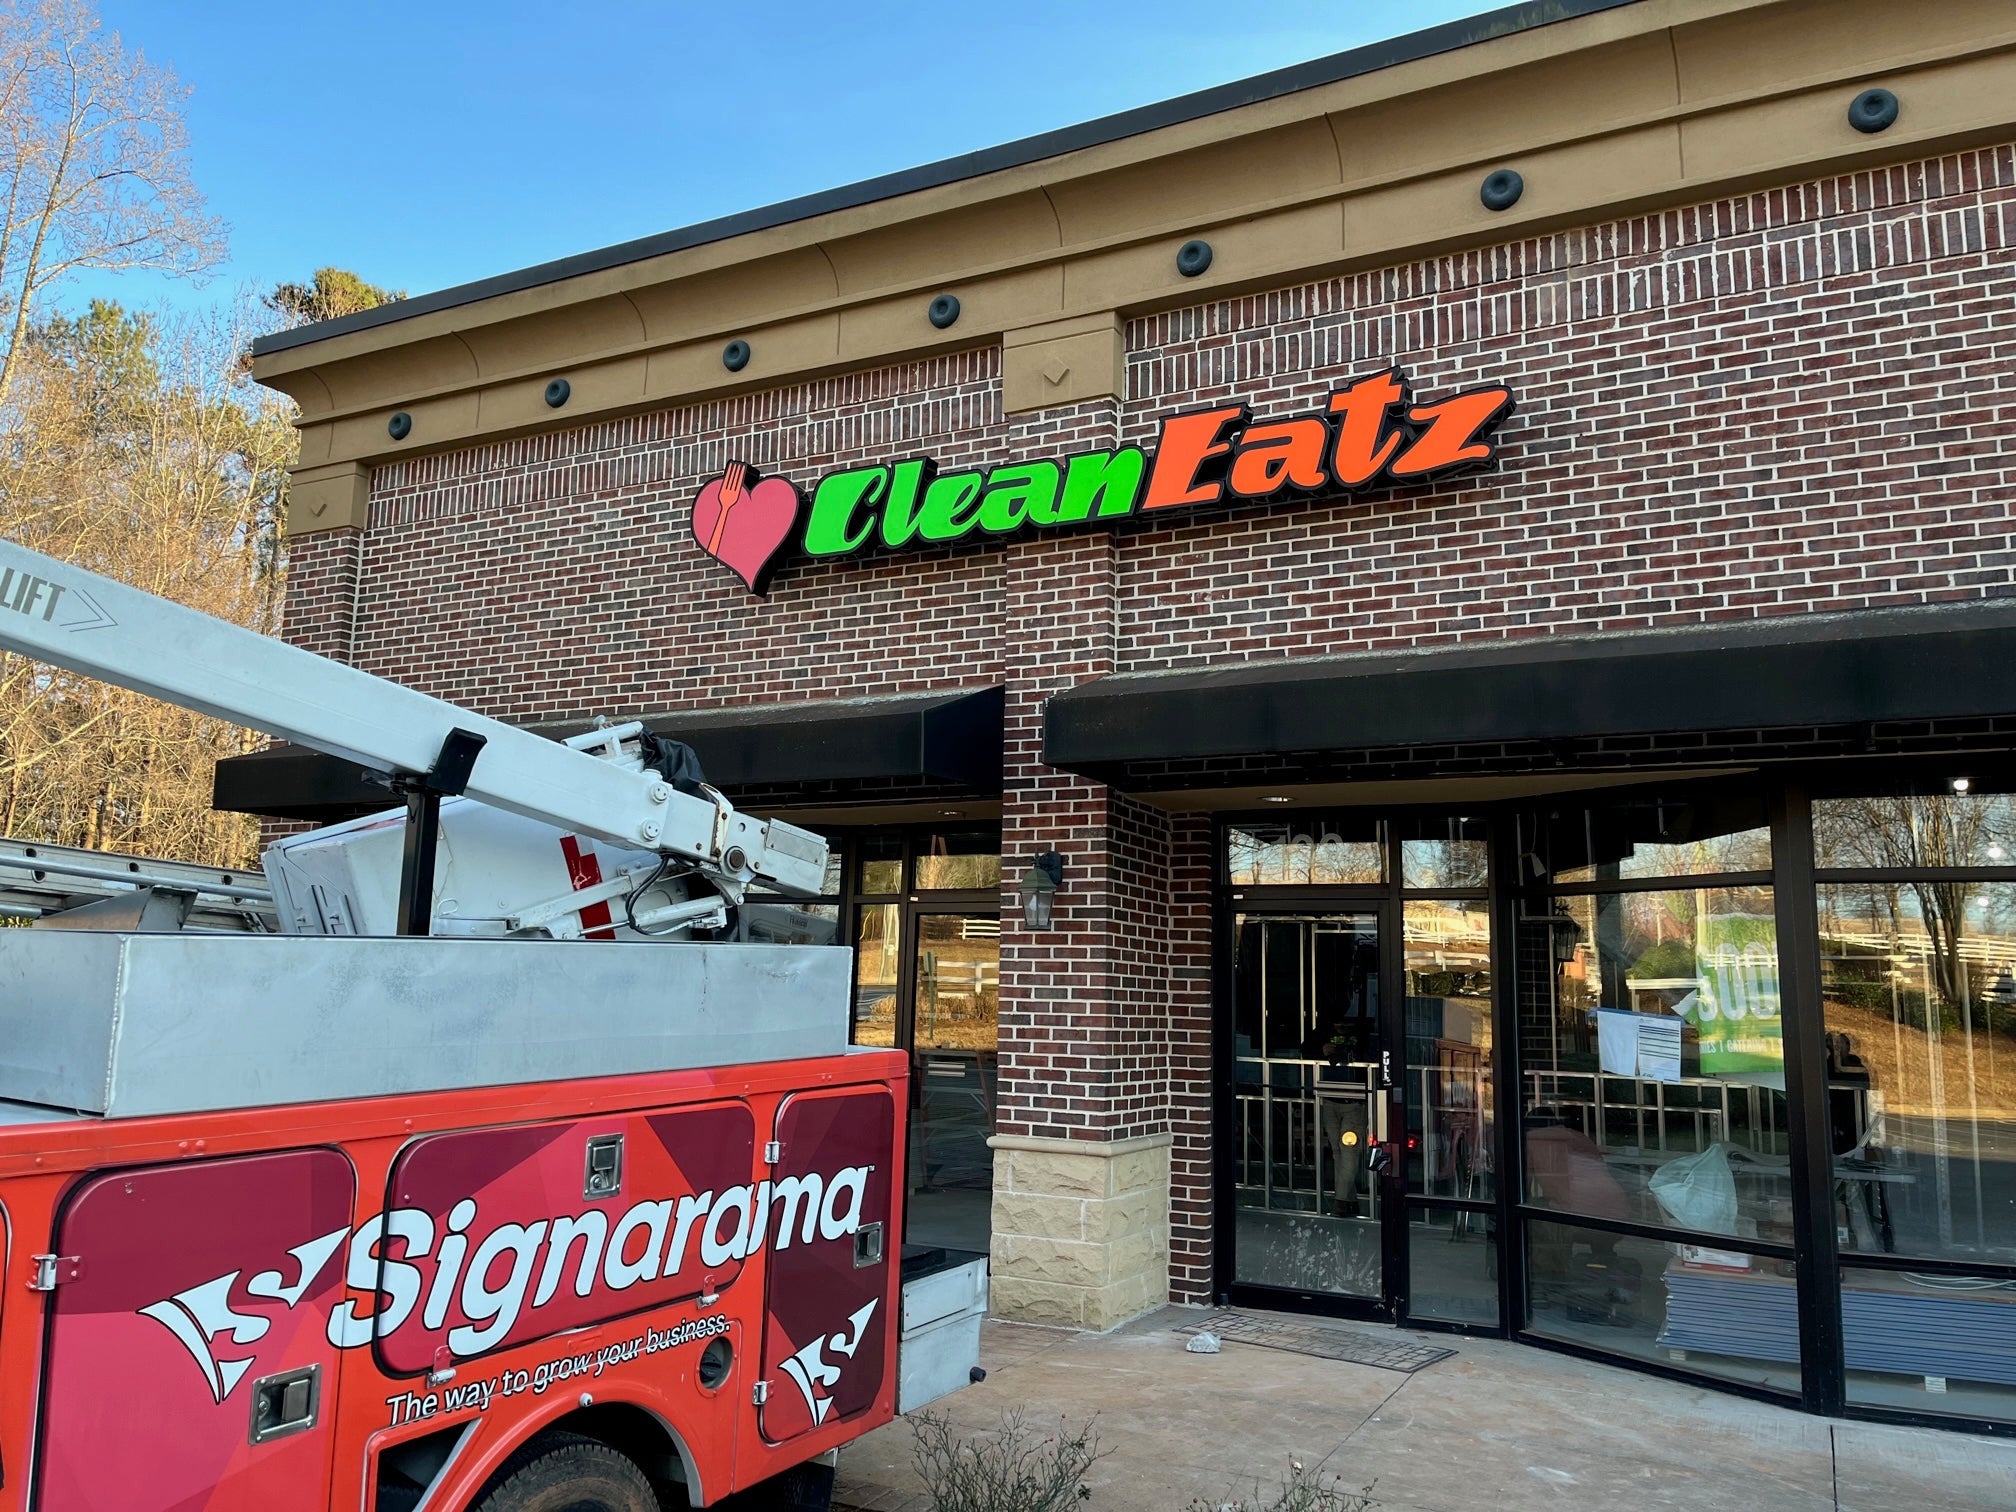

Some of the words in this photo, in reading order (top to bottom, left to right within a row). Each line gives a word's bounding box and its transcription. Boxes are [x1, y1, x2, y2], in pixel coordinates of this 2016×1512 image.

[0, 567, 66, 622] LIFT
[1382, 1050, 1391, 1083] PULL
[327, 1164, 871, 1356] Signarama
[386, 1393, 438, 1426] The
[444, 1378, 498, 1410] way
[502, 1370, 529, 1396] to
[533, 1354, 593, 1394] grow
[593, 1335, 644, 1376] your
[645, 1313, 731, 1354] business.
